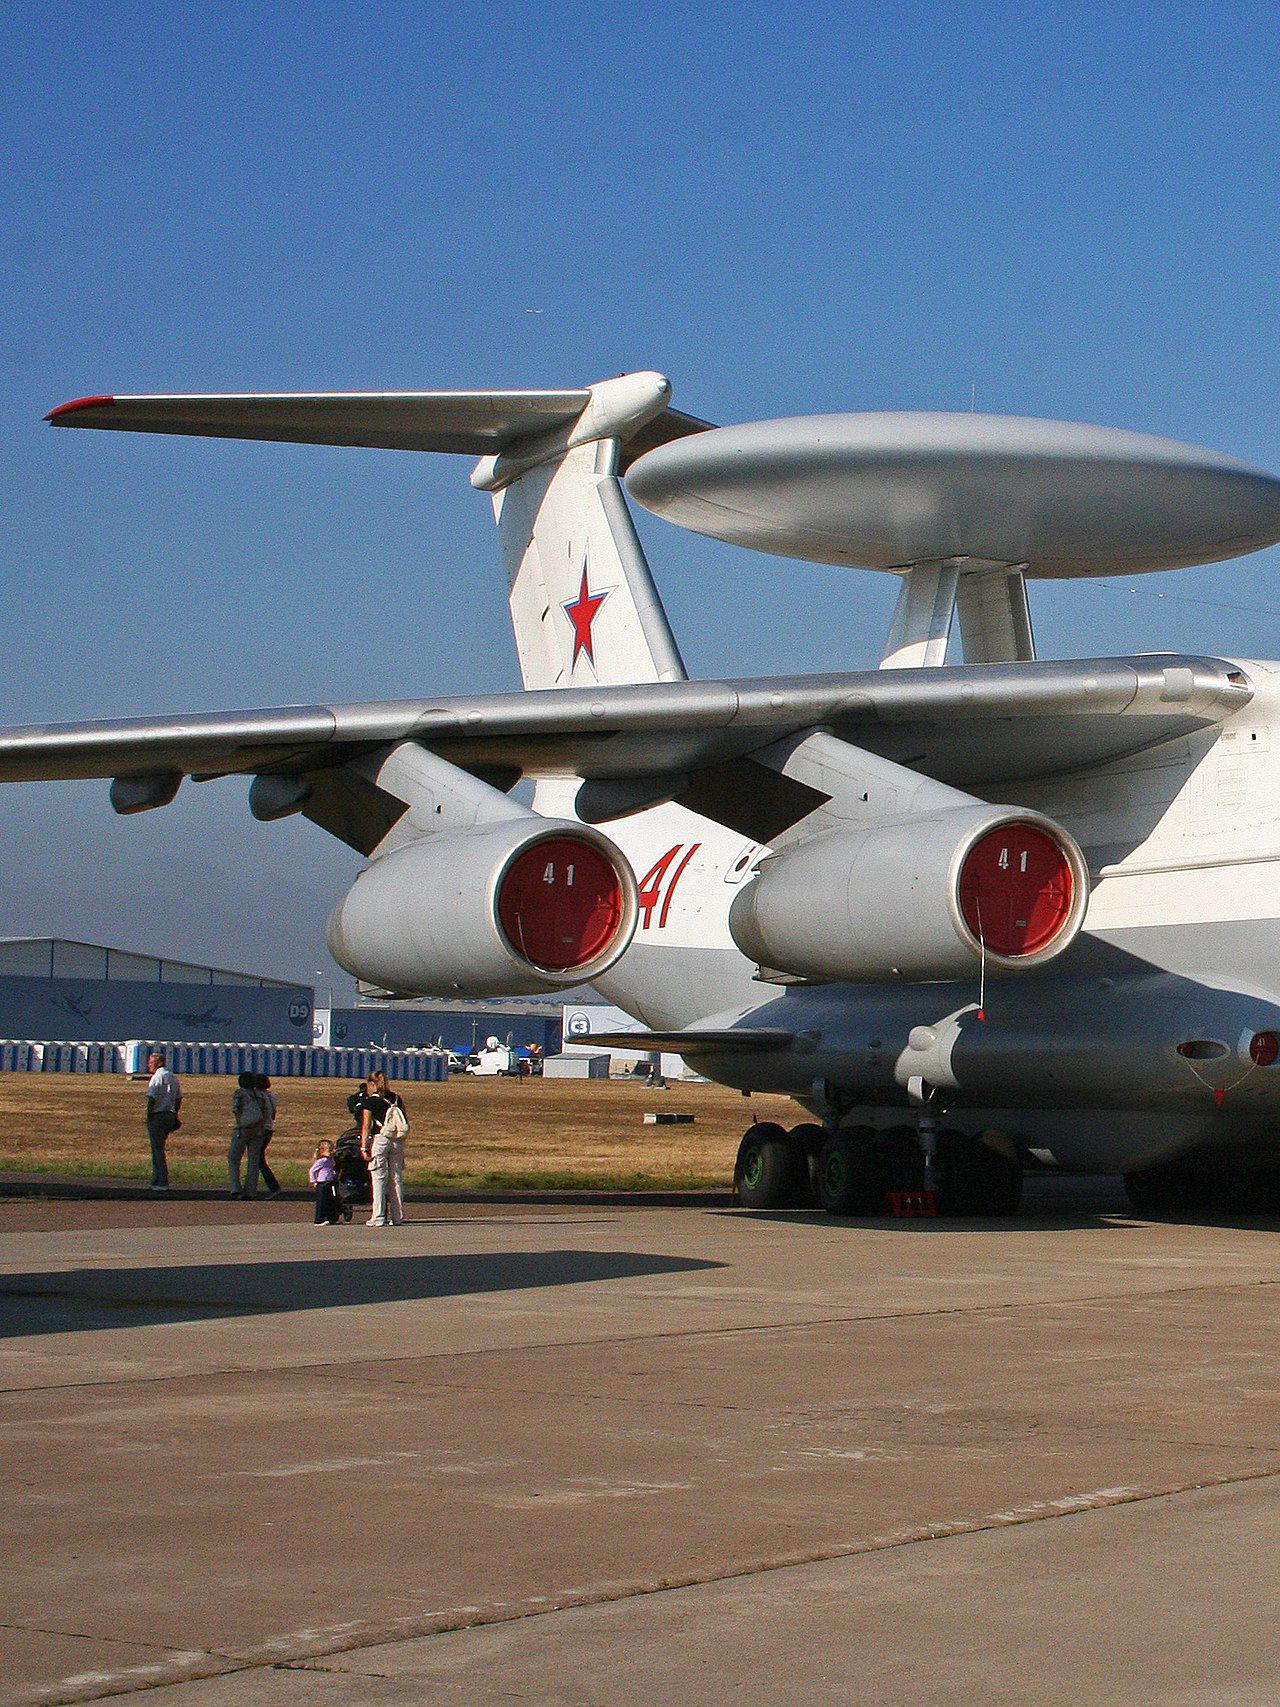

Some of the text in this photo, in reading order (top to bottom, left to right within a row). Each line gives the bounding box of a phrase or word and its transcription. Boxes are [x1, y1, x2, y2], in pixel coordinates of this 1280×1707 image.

[998, 848, 1028, 872] 41
[543, 862, 575, 886] 41
[638, 843, 702, 930] 41
[289, 1005, 307, 1018] D9
[571, 1020, 588, 1034] C3
